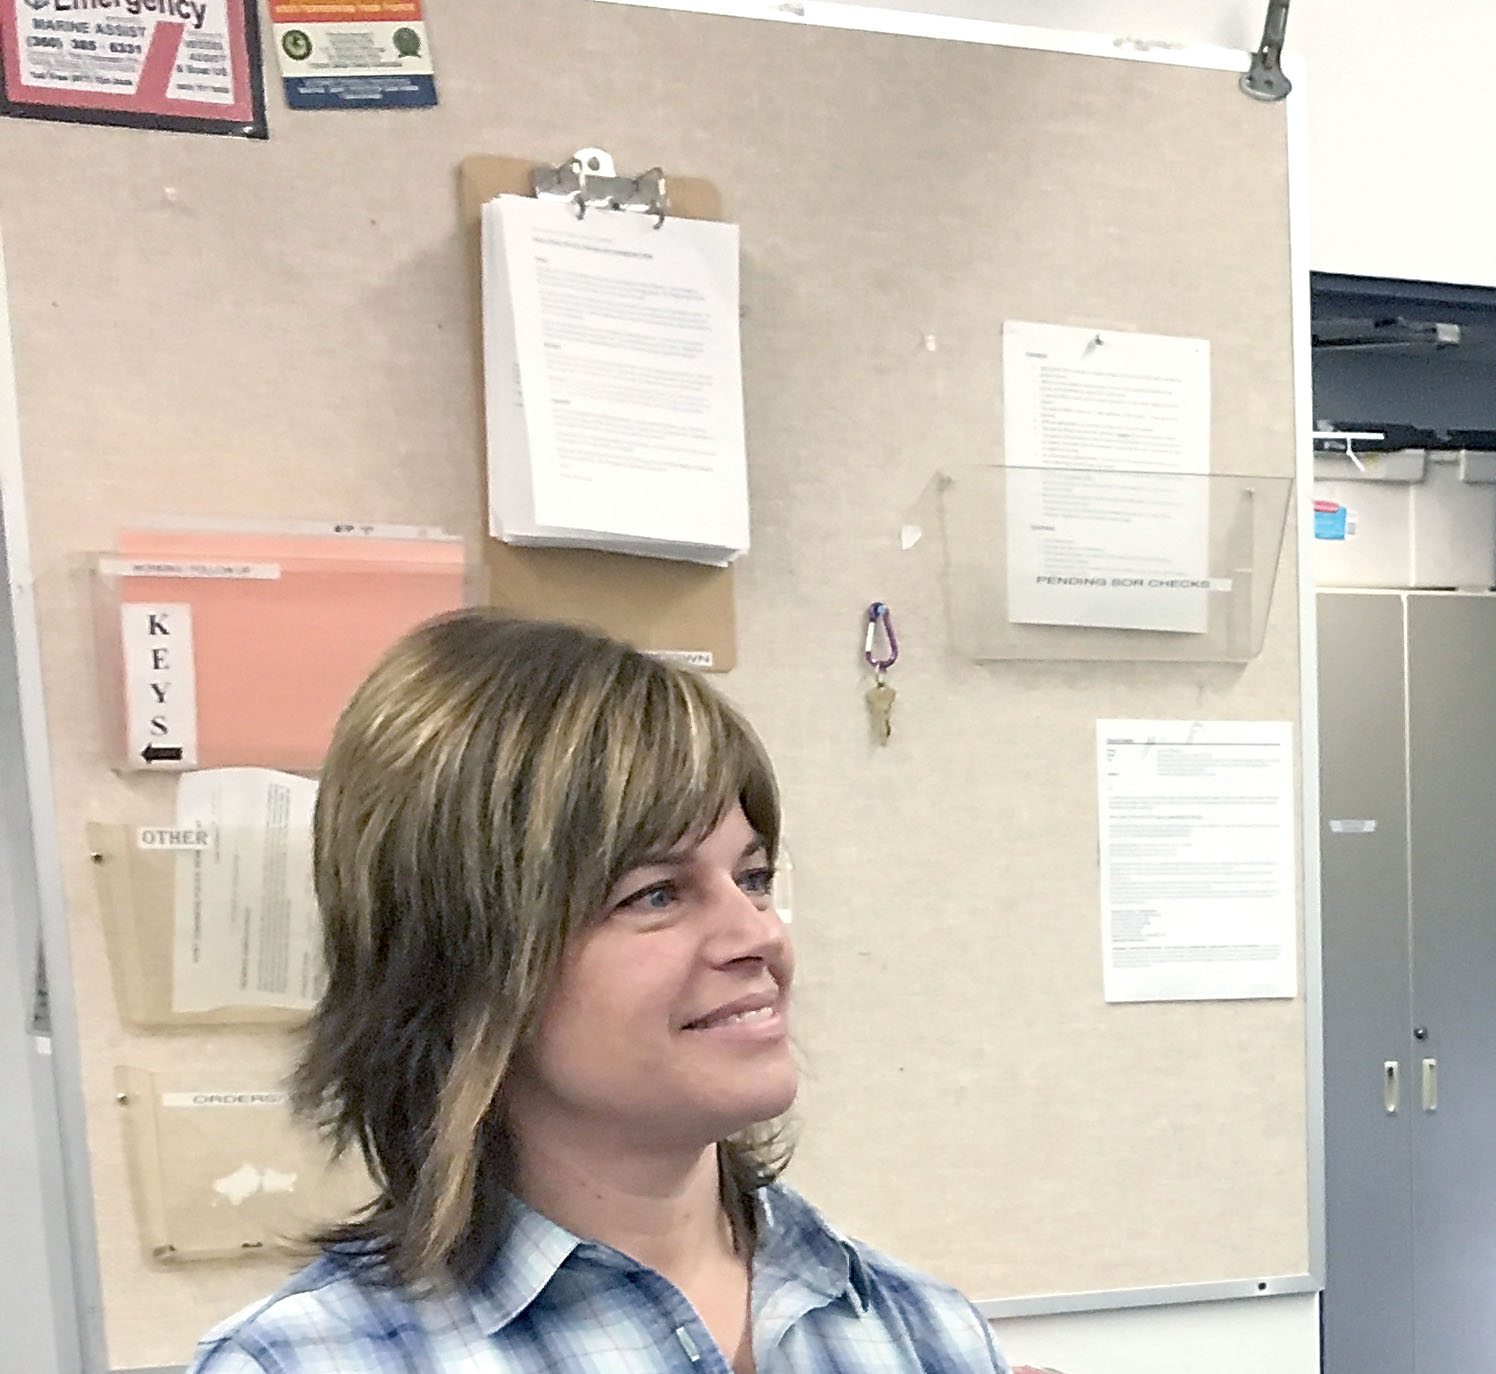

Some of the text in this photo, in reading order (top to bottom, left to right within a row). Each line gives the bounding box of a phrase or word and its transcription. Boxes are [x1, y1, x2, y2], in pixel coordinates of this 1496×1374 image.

[1036, 576, 1107, 586] PENDING
[1148, 579, 1211, 588] CHECKS
[142, 830, 209, 845] OTHER
